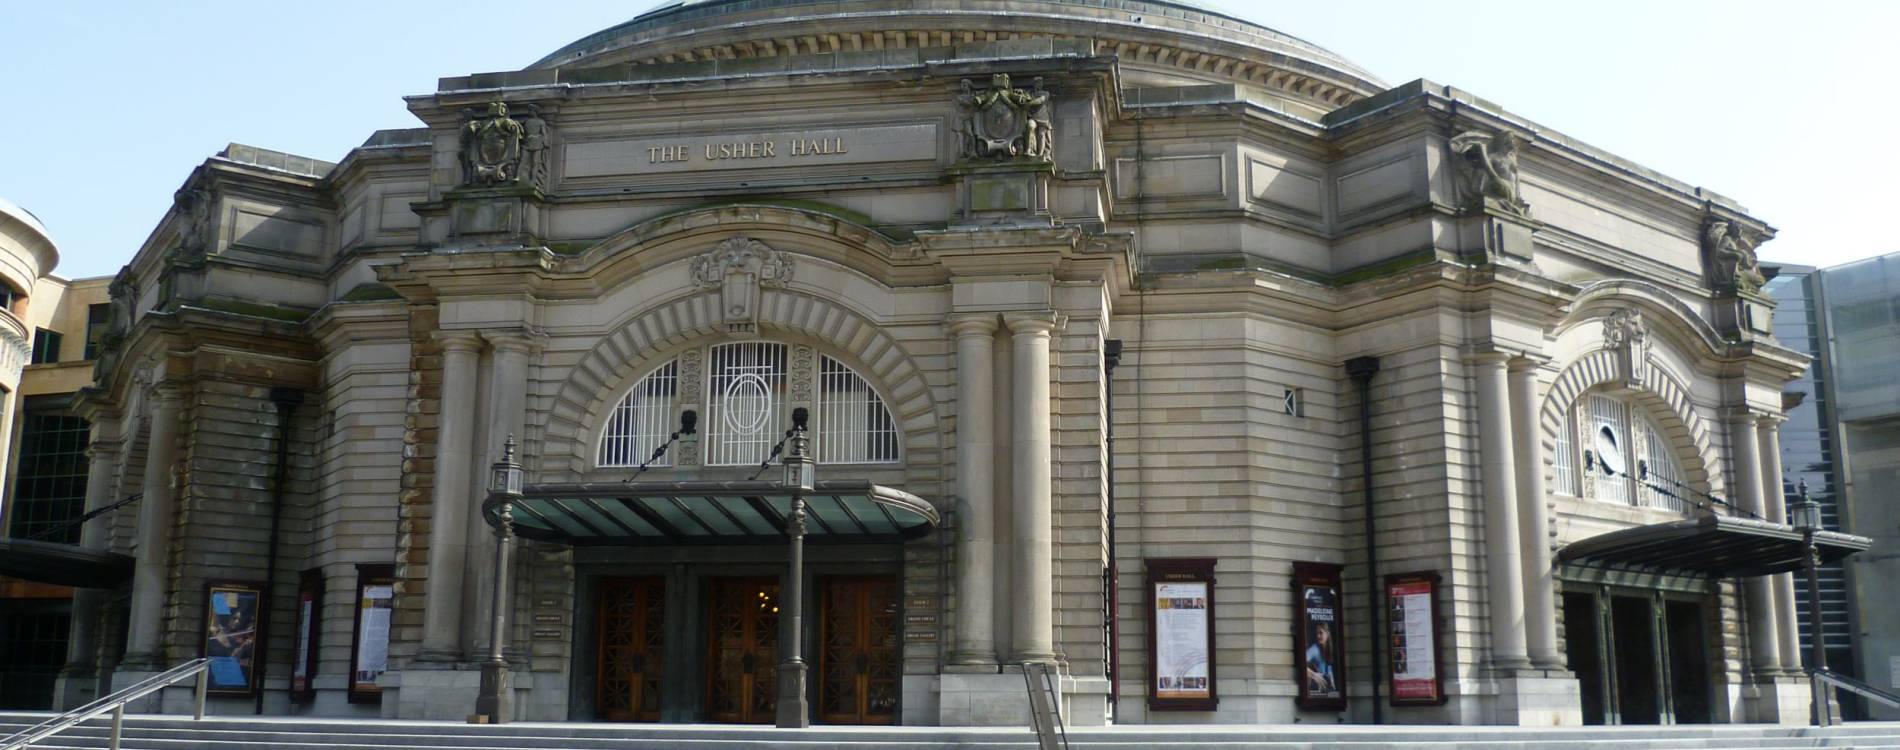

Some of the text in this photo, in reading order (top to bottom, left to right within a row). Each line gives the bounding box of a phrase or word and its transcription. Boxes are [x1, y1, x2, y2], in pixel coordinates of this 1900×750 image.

[648, 137, 848, 163] THE USHER HALL
